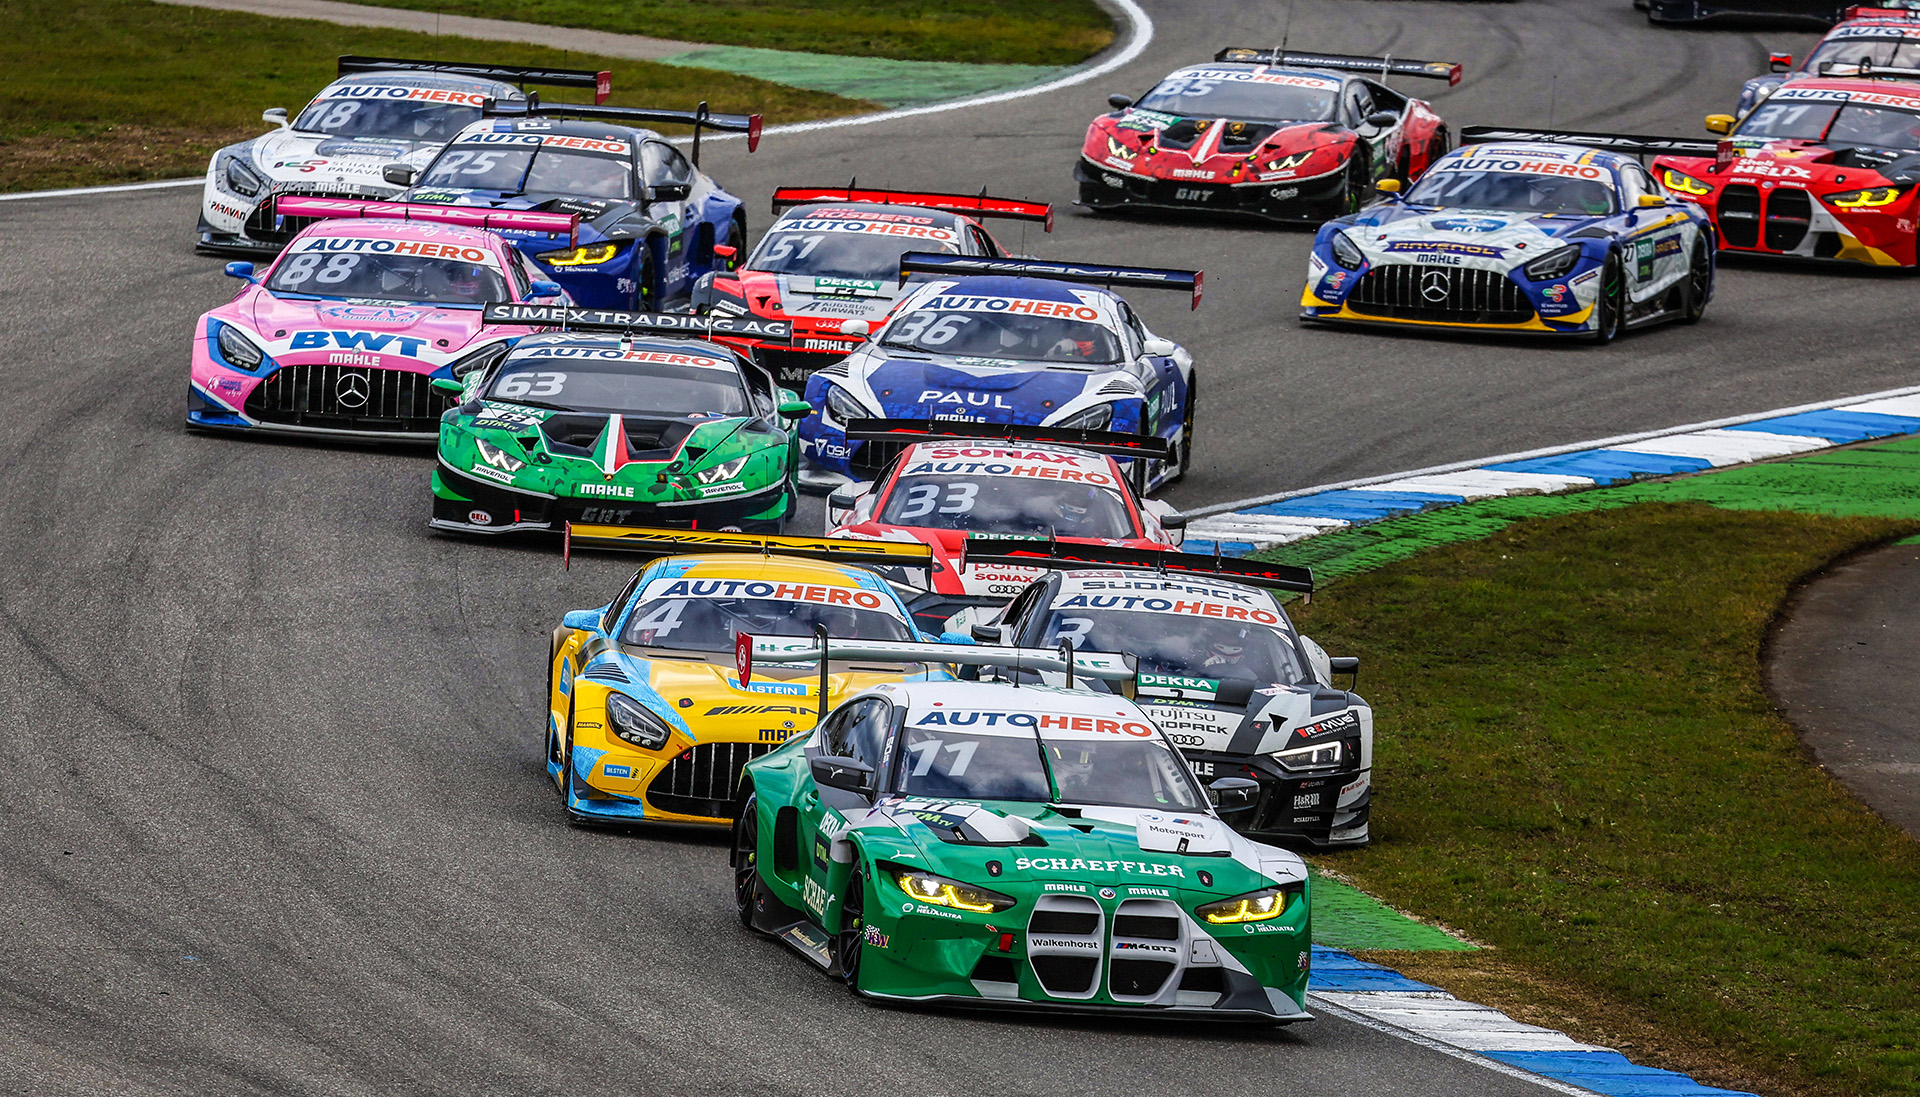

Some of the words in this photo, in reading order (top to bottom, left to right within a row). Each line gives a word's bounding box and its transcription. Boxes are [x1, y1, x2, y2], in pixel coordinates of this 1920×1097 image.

[1185, 71, 1325, 87] AUTOHERO
[330, 86, 484, 105] AUTOHERO
[302, 101, 361, 130] 18
[1749, 105, 1812, 125] 31
[462, 133, 625, 152] AUTOHERO
[441, 152, 507, 176] 25
[1446, 159, 1601, 179] AUTOHERO
[1732, 164, 1812, 179] HELIX
[1738, 158, 1775, 167] Shell
[1173, 168, 1215, 180] MAHLE
[315, 182, 361, 194] MAHLE
[1417, 172, 1475, 200] 27
[783, 219, 951, 240] AUTOHERO
[305, 239, 484, 262] AUTOHERO
[762, 235, 825, 262] 51
[1393, 242, 1499, 256] RAVENOL
[1624, 244, 1635, 263] 27
[1416, 253, 1461, 265] MAHLE
[279, 254, 361, 284] 88
[820, 278, 875, 289] DEKRA
[820, 308, 865, 316] AIRWAYS
[923, 295, 1099, 321] AUTOHERO
[493, 305, 587, 322] SIMEX
[594, 311, 733, 331] TRADING
[744, 320, 786, 336] AG
[891, 311, 971, 345] 36
[289, 331, 427, 357] BWT
[804, 338, 853, 352] MAHLE
[329, 352, 380, 367] MAHLE
[530, 348, 716, 367] AUTOHERO
[495, 371, 567, 397] 63
[918, 389, 1012, 410] PAUL
[489, 402, 546, 418] DEKRA
[931, 449, 1080, 467] SONAX
[476, 466, 510, 481] RAVENOL
[911, 463, 1109, 484] AUTOHERO
[581, 483, 635, 498] MAHLE
[705, 484, 742, 494] RAVENOL
[899, 482, 980, 518] 33
[471, 513, 488, 521] BELL
[975, 573, 1033, 583] SONAX
[661, 581, 881, 609] AUTOHERO
[1060, 595, 1278, 624] AUTOHERO
[635, 602, 684, 638] 4
[1055, 617, 1095, 650] 3
[1141, 673, 1212, 690] DEKRA
[920, 711, 1153, 738] AUTOHERO
[1150, 708, 1216, 722] FUJITSU
[1305, 714, 1355, 736] REMUS
[912, 740, 981, 776] 11
[1149, 825, 1206, 840] Motorsport
[1016, 857, 1185, 878] SCHAEFFLER
[1044, 883, 1086, 893] MAHLE
[1128, 887, 1170, 897] MAHLE
[940, 911, 962, 920] ULTRA
[1032, 938, 1098, 951] Walkenhorst
